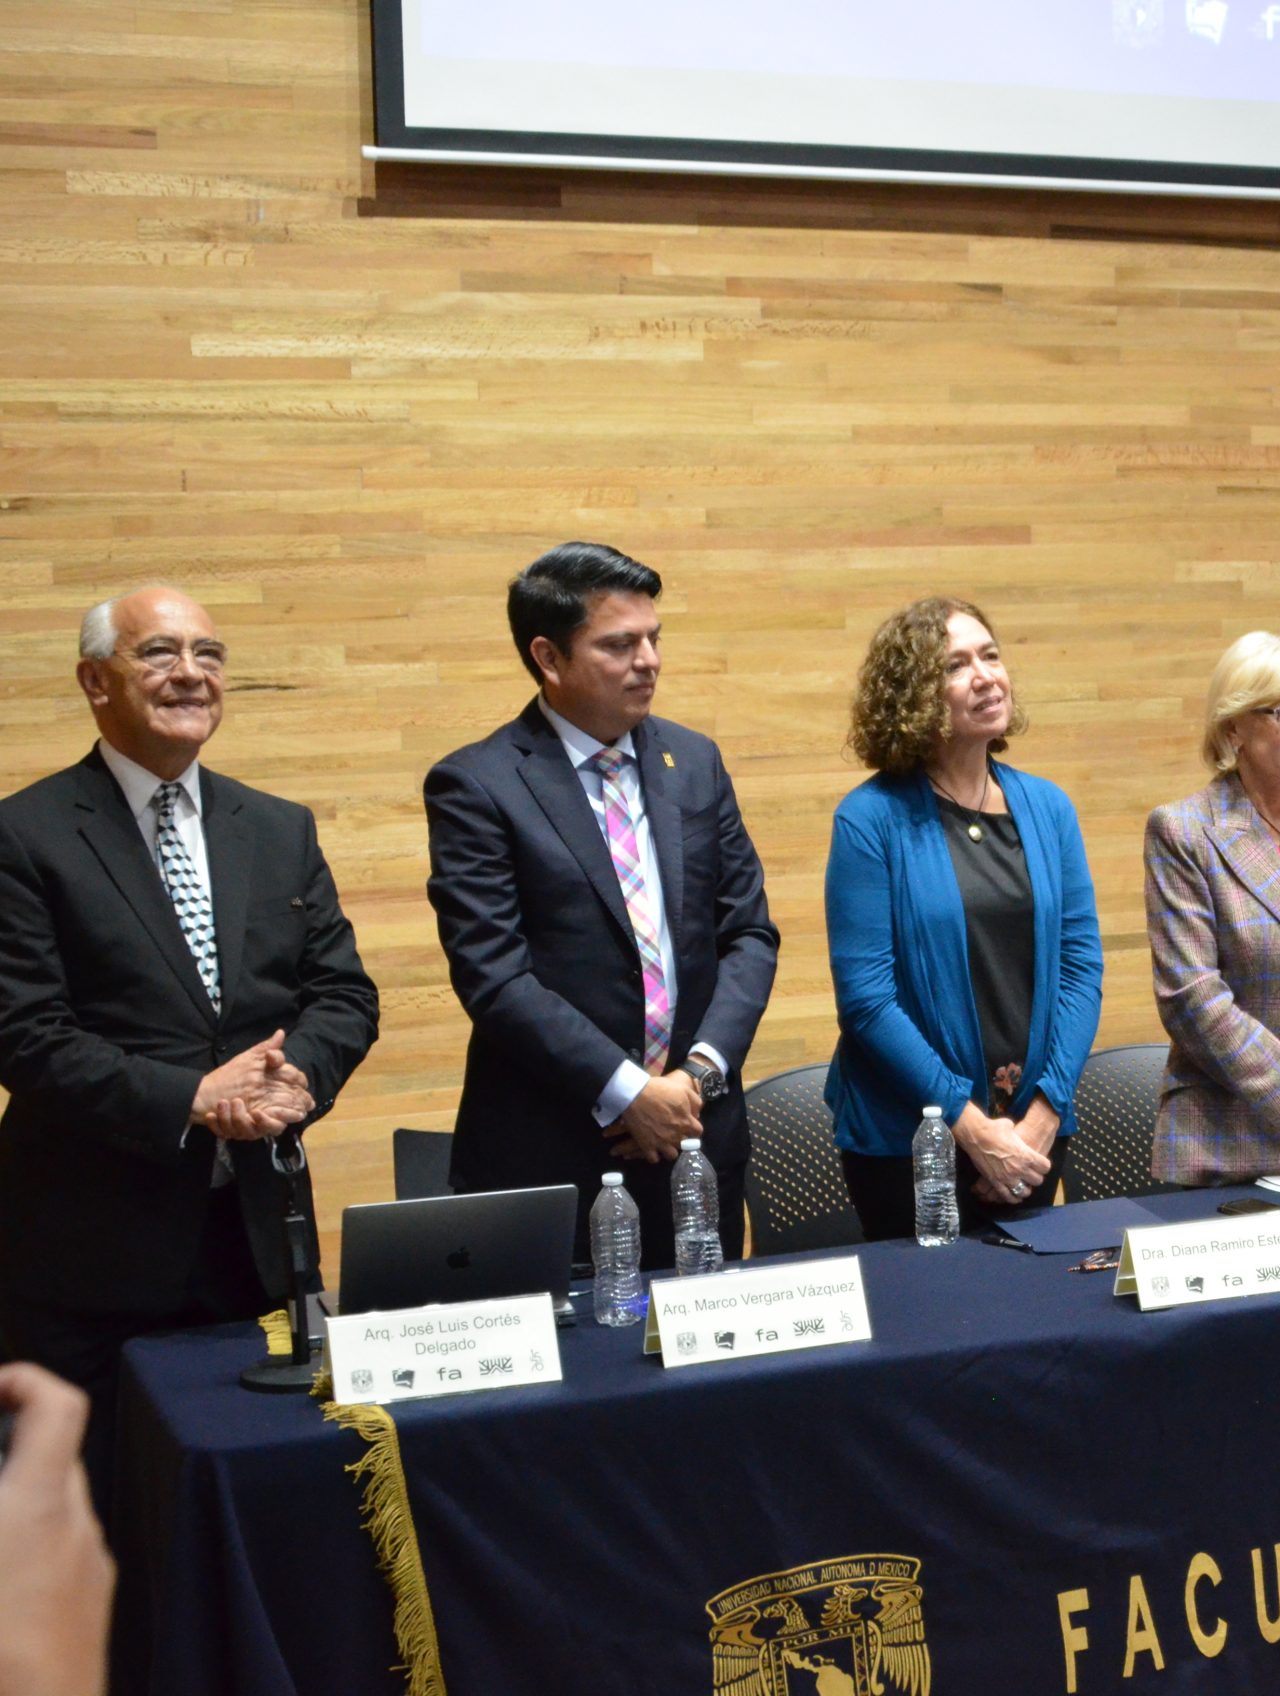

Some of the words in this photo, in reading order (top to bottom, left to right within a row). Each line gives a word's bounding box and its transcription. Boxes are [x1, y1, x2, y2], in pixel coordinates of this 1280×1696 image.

[1141, 1248, 1168, 1261] Dra.
[1172, 1243, 1207, 1257] Diana
[1211, 1238, 1255, 1253] Ramiro
[1222, 1274, 1244, 1287] fa
[662, 1303, 690, 1317] Arq.
[695, 1294, 737, 1312] Marco
[741, 1288, 794, 1306] Vergara
[796, 1280, 856, 1299] Vázquez
[364, 1327, 393, 1342] Arq.
[399, 1321, 434, 1338] José
[438, 1319, 469, 1334] Luis
[473, 1312, 521, 1330] Cortés
[755, 1328, 779, 1342] fa
[415, 1337, 477, 1356] Delgado
[436, 1367, 462, 1382] fa
[717, 1582, 772, 1615] UNIVERSIDAD
[774, 1570, 817, 1592] NACIONAL
[821, 1561, 866, 1582] AUTONOMA
[878, 1561, 910, 1577] MEXICO
[783, 1632, 819, 1649] POR
